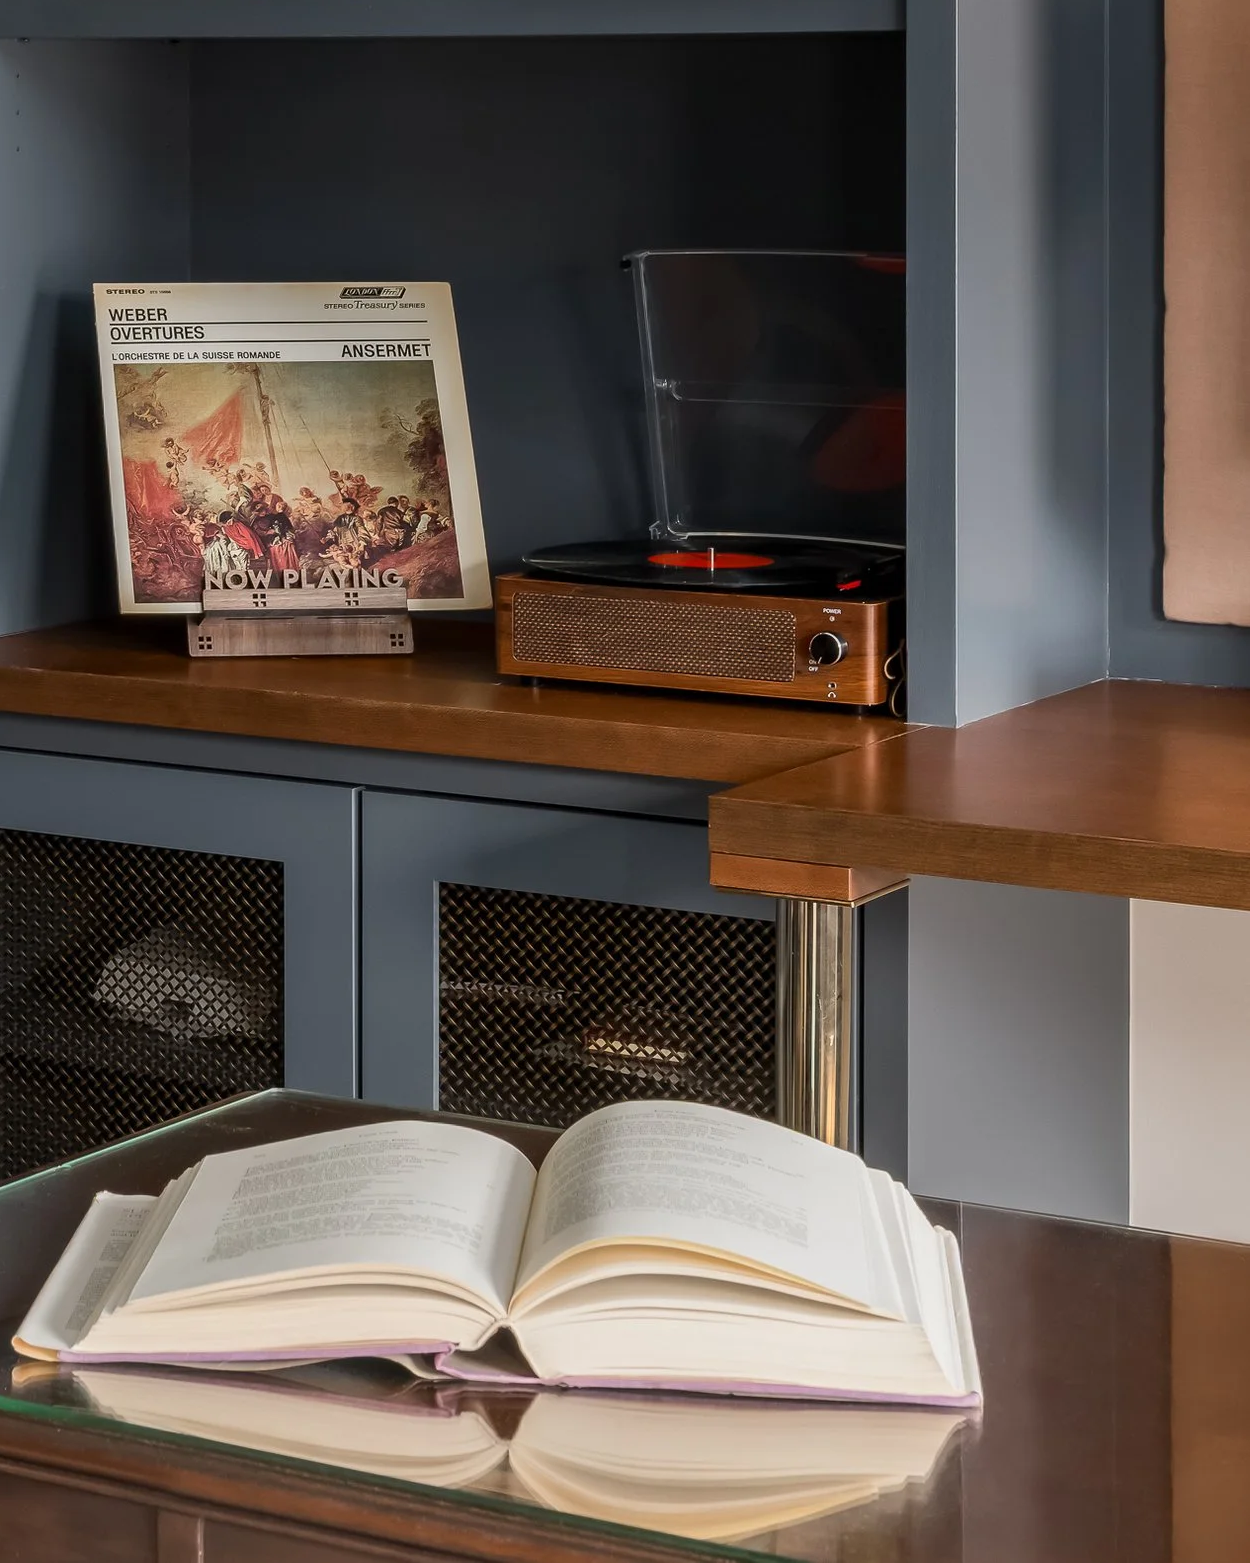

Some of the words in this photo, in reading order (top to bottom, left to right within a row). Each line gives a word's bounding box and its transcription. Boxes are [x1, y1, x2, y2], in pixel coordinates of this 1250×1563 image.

[354, 300, 398, 310] Treasury
[108, 308, 168, 322] WEBER
[110, 326, 205, 340] OVERTURES
[112, 352, 170, 361] L'ORCHESTRE
[173, 352, 185, 360] DE
[187, 352, 199, 360] LA
[202, 351, 234, 360] SUISSE
[237, 351, 281, 359] ROMANDE
[341, 343, 431, 357] ANSERMET
[204, 568, 273, 590] NOW
[283, 568, 404, 589] PLAYING
